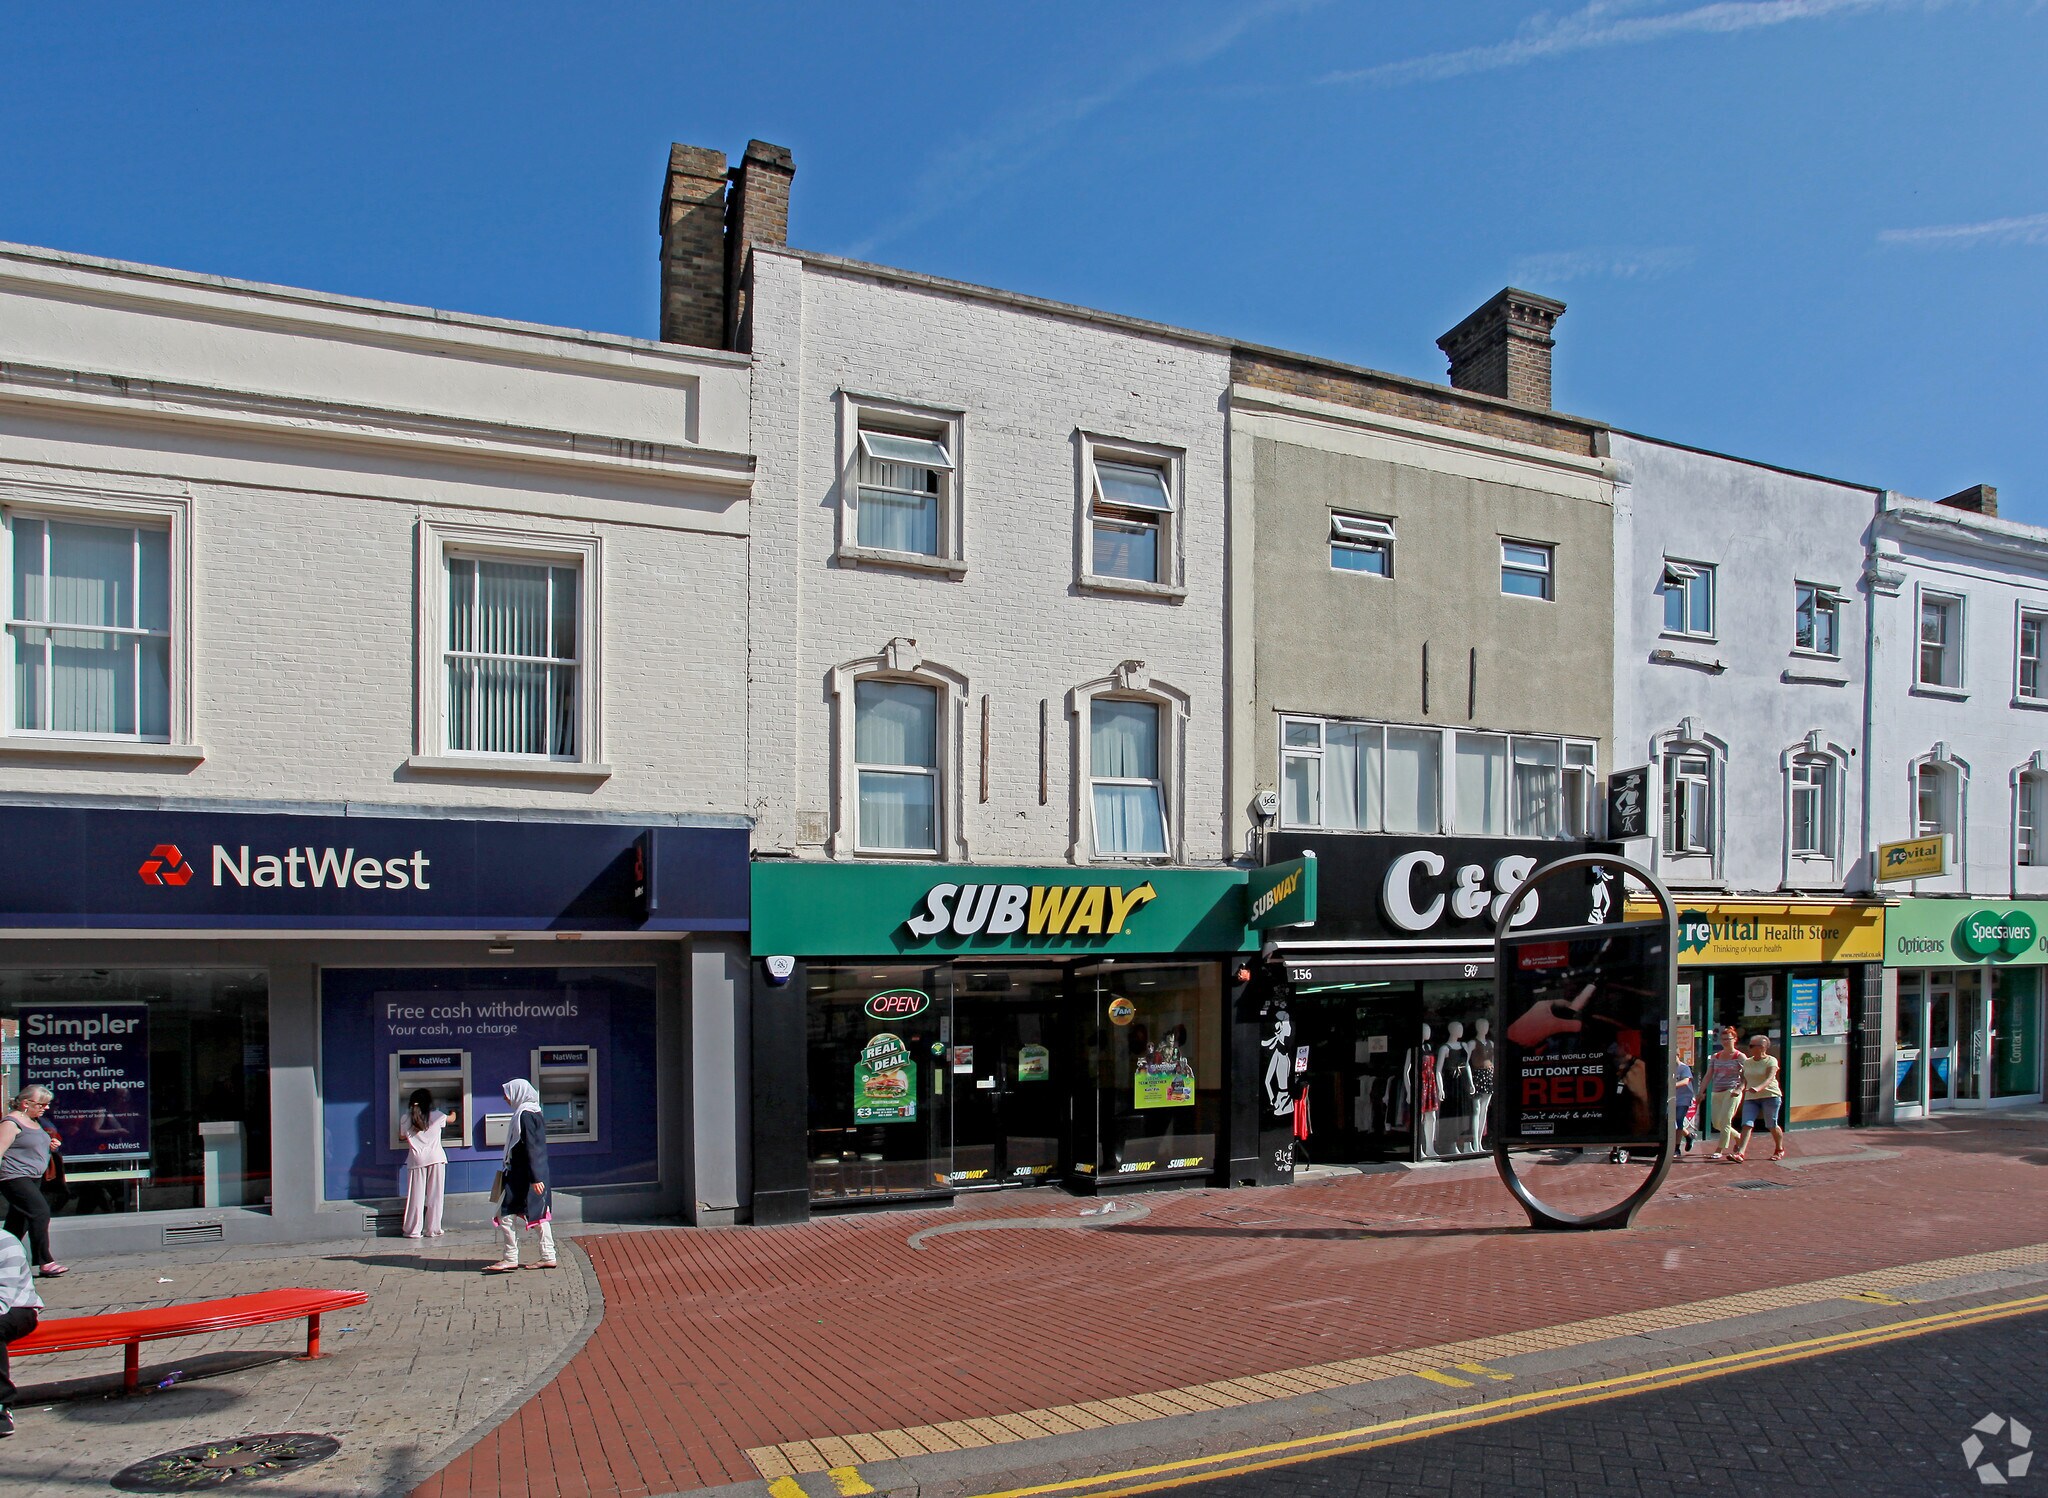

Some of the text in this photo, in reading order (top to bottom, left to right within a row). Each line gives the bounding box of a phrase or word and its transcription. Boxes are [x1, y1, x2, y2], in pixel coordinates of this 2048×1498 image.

[1622, 816, 1637, 833] K
[1893, 845, 1936, 860] revital
[212, 844, 430, 890] NatWest
[1251, 868, 1302, 922] SUBWAY
[907, 882, 1157, 938] SUBWAY
[1686, 916, 1839, 941] revital Health Store
[1972, 922, 2030, 942] Specsavers
[1713, 944, 1782, 955] Thinking of your health
[1898, 936, 1944, 956] Opticians
[1293, 968, 1312, 980] 156
[387, 1001, 578, 1019] Free cash withdrawals
[873, 997, 920, 1012] OPEN
[27, 1014, 140, 1040] Simpler
[388, 1022, 518, 1036] Your cash, no charge
[28, 1042, 122, 1052] Rates that are
[867, 1042, 898, 1059] REAL
[2010, 1029, 2022, 1064] Contact
[27, 1054, 105, 1065] the same in
[552, 1053, 582, 1061] NatWest
[875, 1055, 905, 1071] DEAL
[28, 1067, 124, 1079] branch, online
[1522, 1065, 1603, 1077] BUT DON'T SEE
[78, 1080, 100, 1090] the
[103, 1079, 145, 1091] phone
[1522, 1076, 1604, 1105] RED
[857, 1108, 872, 1116] £3
[1521, 1112, 1546, 1120] Don't
[1548, 1112, 1570, 1120] drink
[1013, 1164, 1052, 1176] SUBWAY
[1119, 1160, 1155, 1173] SUBWAY
[1167, 1157, 1203, 1169] SUBWAY
[950, 1169, 988, 1180] SUBWAY
